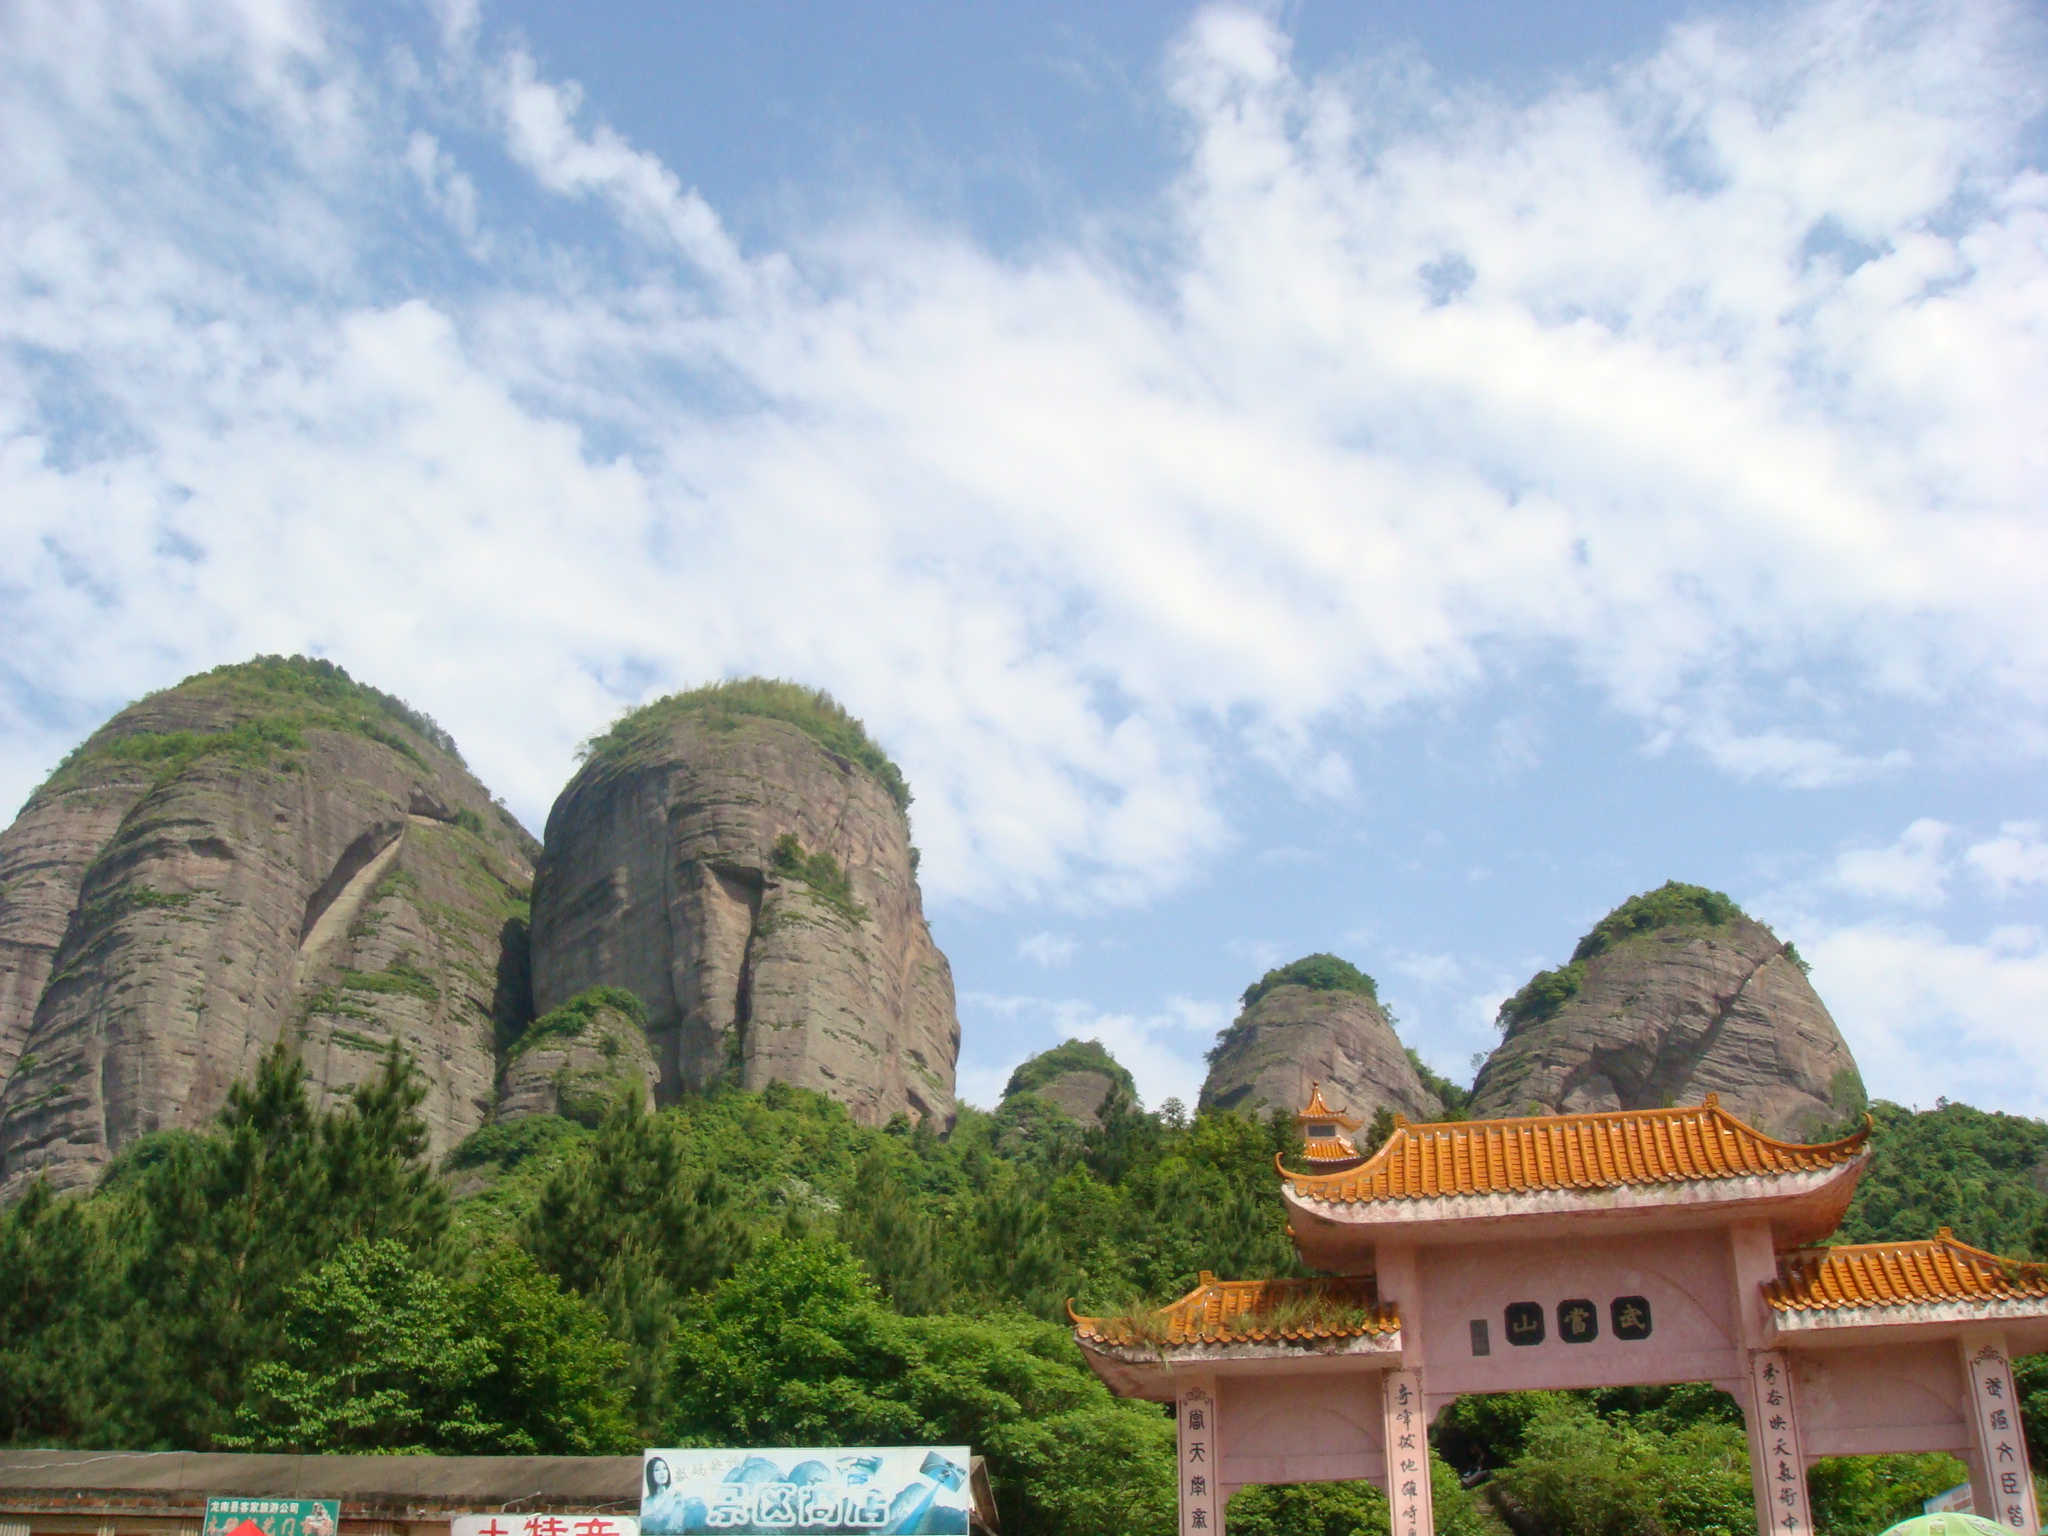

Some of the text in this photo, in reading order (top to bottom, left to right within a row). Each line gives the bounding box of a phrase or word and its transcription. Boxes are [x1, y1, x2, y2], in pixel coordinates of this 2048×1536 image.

[210, 1501, 300, 1514] 龙南县客家旅游公司
[706, 1482, 891, 1527] 景区商店
